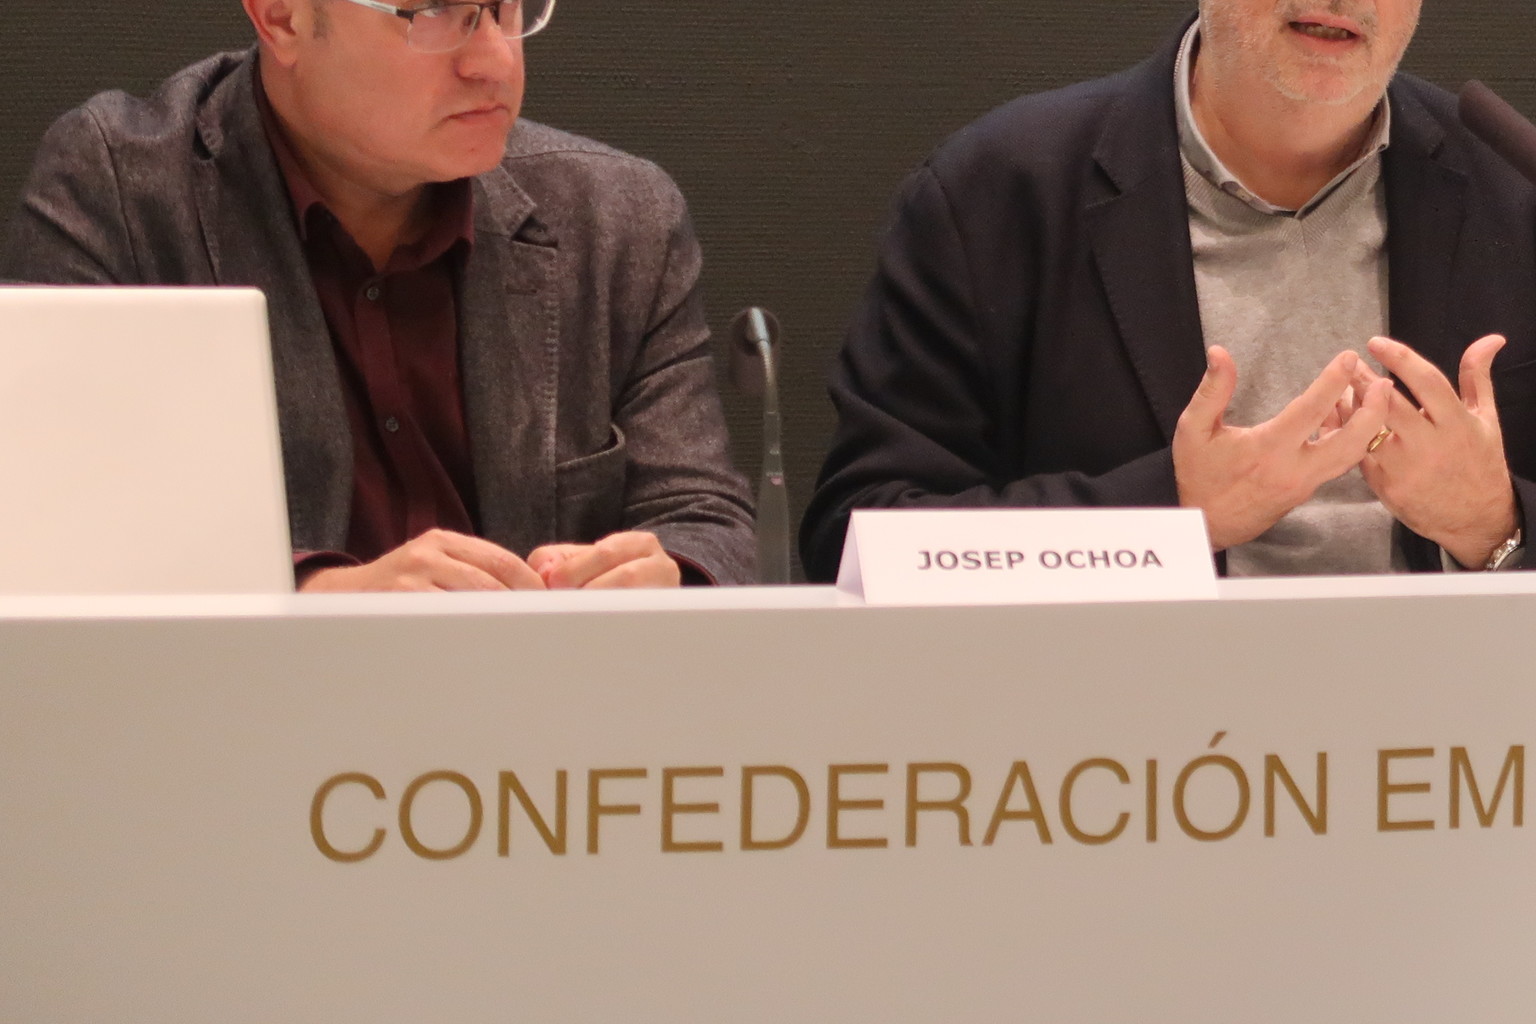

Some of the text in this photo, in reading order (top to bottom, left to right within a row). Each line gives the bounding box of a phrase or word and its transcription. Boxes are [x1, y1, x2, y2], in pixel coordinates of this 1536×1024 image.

[917, 548, 1164, 571] JOSEP OCHOA
[308, 730, 1329, 864] CONFEDERACIÓN
